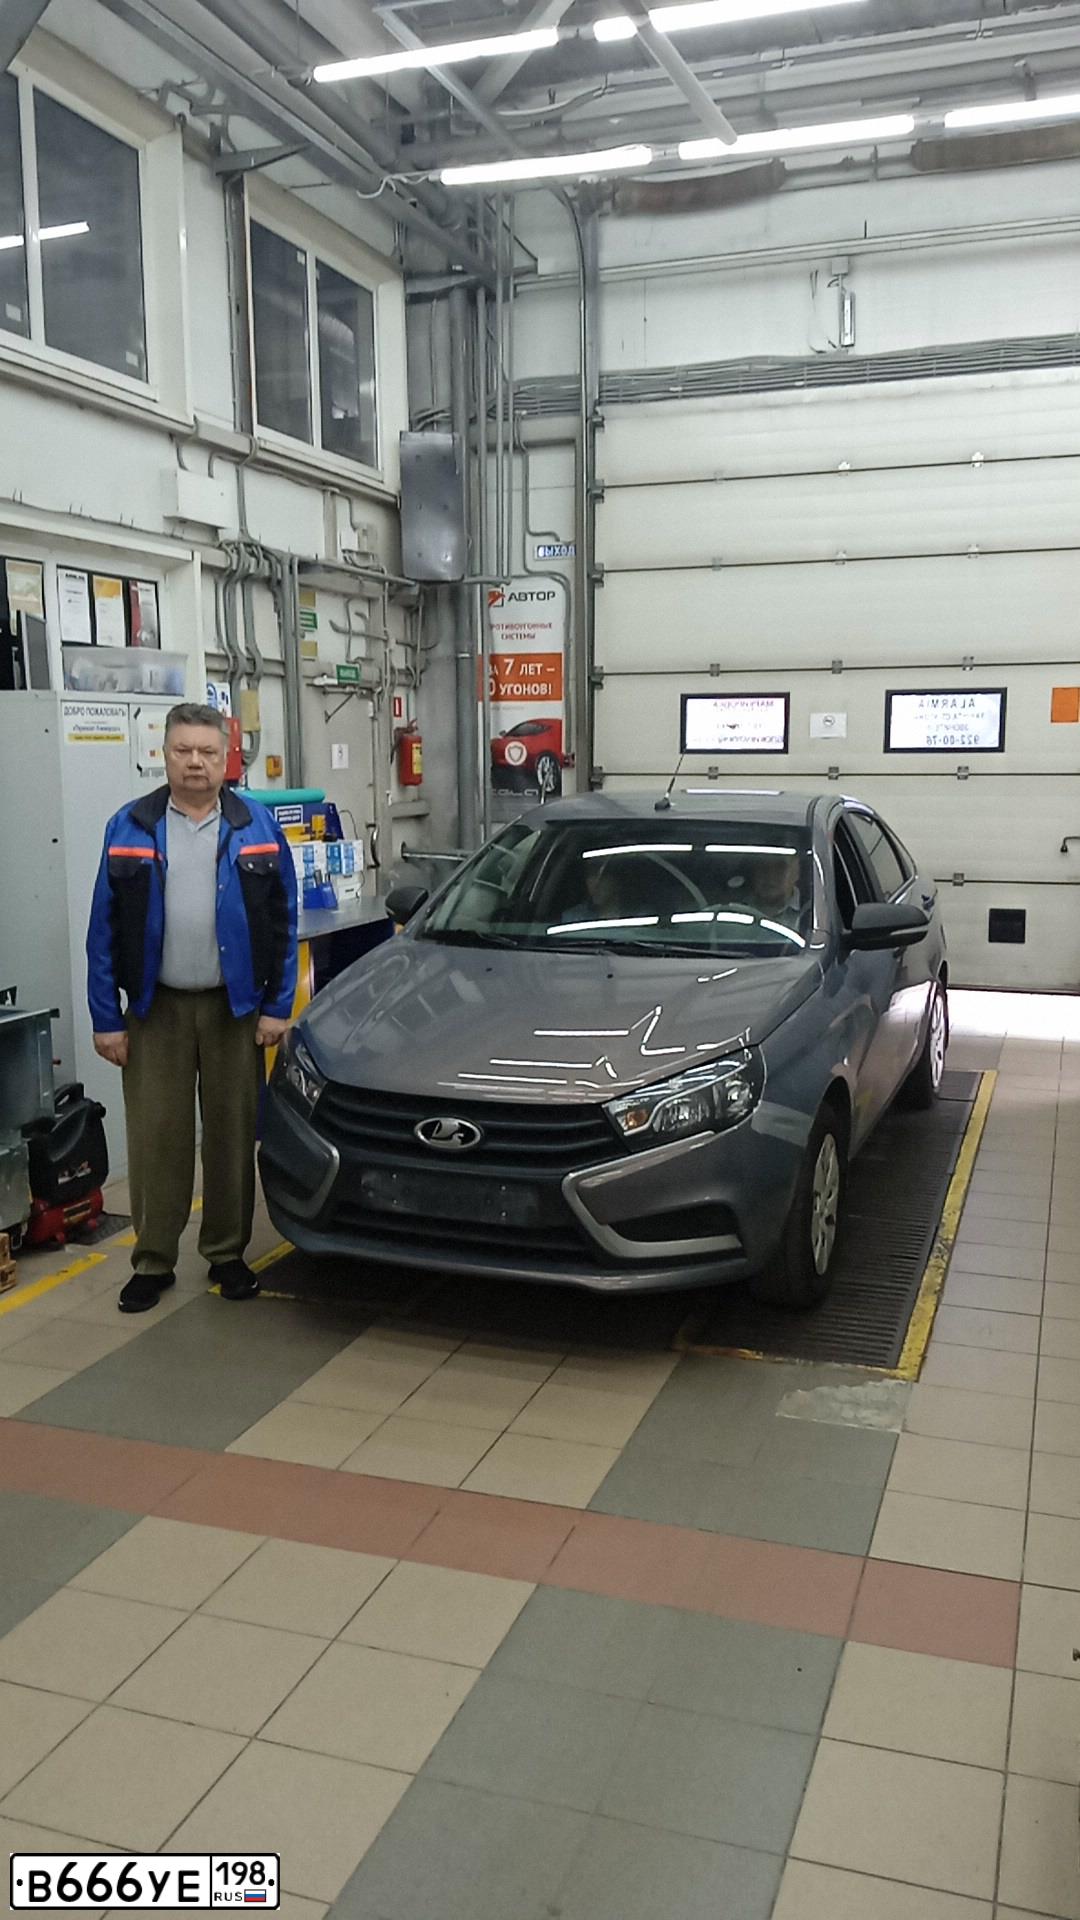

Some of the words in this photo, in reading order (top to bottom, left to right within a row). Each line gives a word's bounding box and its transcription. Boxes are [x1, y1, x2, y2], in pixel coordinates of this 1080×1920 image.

[507, 591, 556, 602] АВТОР
[490, 622, 553, 630] РОТИВОУГОННЫХ
[503, 658, 515, 676] 7
[519, 663, 543, 676] ЛЕТ
[499, 683, 552, 696] УГОНОВ!
